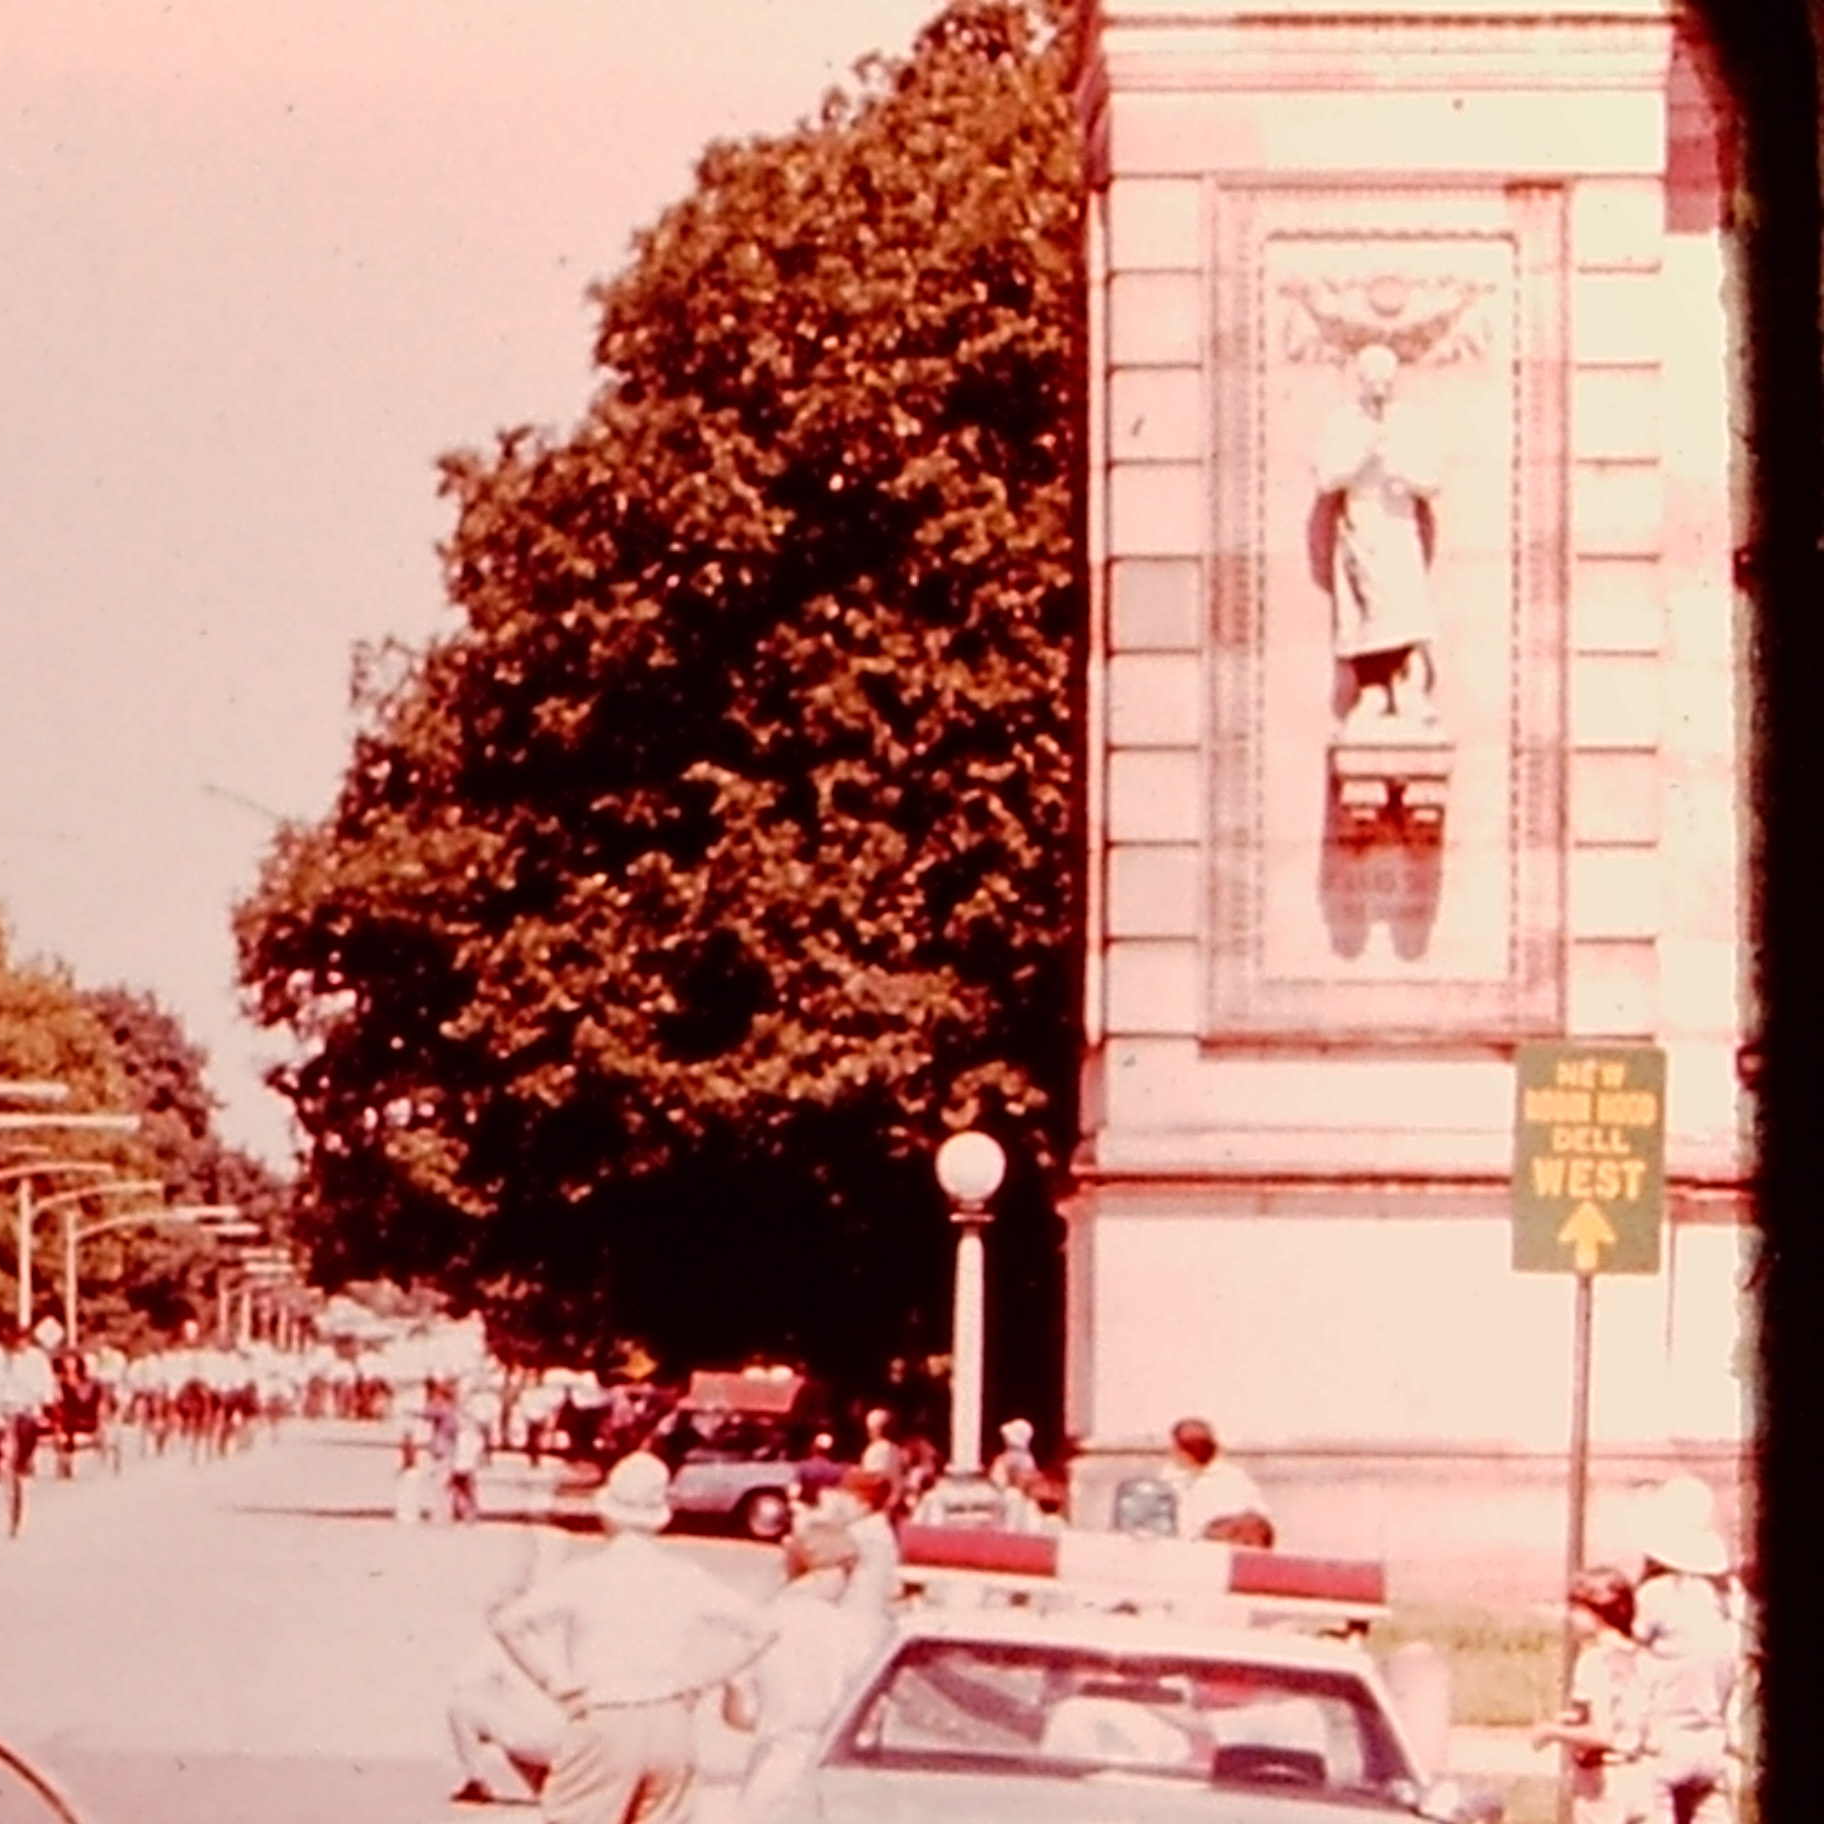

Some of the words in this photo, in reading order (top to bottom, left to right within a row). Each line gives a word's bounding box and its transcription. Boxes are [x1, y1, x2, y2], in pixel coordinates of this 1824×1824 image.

[1556, 1060, 1627, 1087] NEW
[1553, 1126, 1630, 1152] DELL
[1532, 1156, 1647, 1200] WEST
